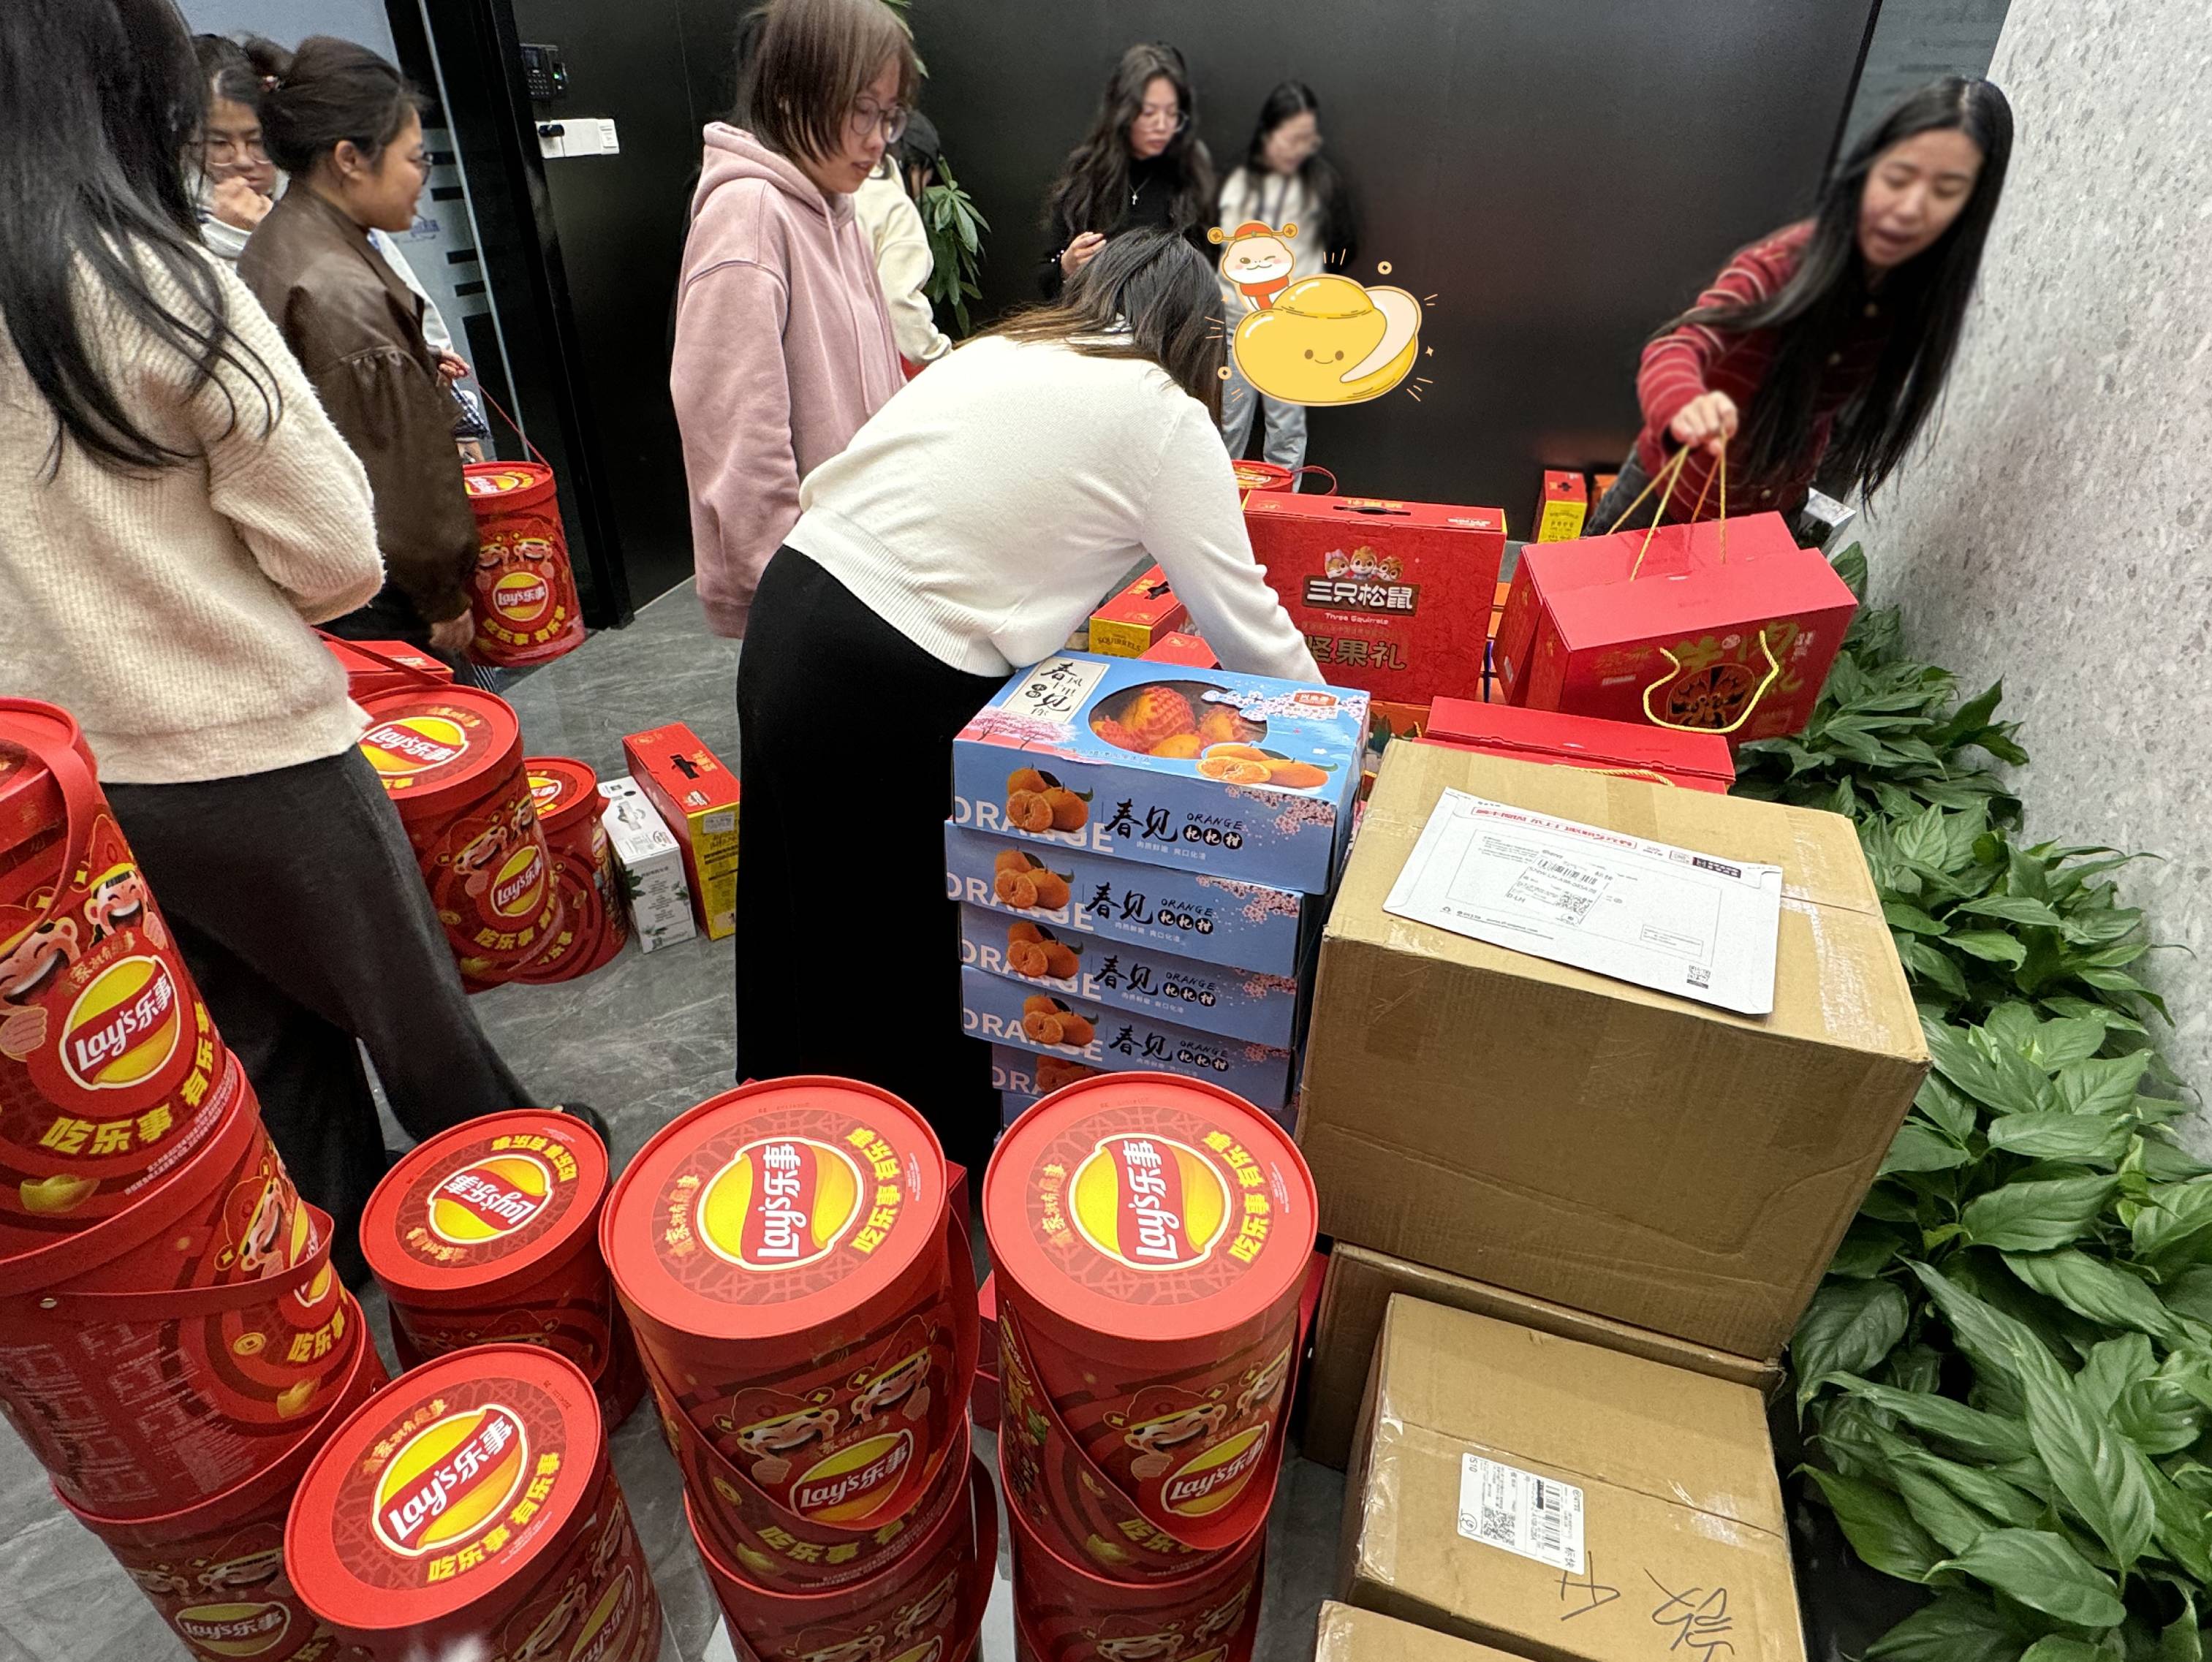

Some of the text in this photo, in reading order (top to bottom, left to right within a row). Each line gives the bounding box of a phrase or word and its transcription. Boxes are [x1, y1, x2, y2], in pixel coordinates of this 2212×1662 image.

[1307, 580, 1413, 610] 三只松鼠
[1325, 612, 1389, 626] Three Squirrels
[1097, 636, 1142, 652] SQUIRRELS
[1105, 798, 1178, 842] 春见
[1187, 812, 1243, 830] ORANGE
[1085, 881, 1154, 925] 春见
[1161, 898, 1214, 918] ORANGE
[1094, 955, 1159, 996] 春见
[1166, 971, 1217, 991] ORANGE
[75, 973, 172, 1072] Lay's乐事
[1108, 1025, 1174, 1060] 春见
[1181, 1039, 1229, 1058] ORANGE
[39, 1103, 173, 1156] 吃乐事
[180, 1001, 213, 1108] 有乐事
[444, 1175, 537, 1224] Lay's乐事
[757, 1142, 807, 1258] Lay's乐事
[844, 1127, 902, 1256] 吃乐事 有乐事
[1122, 1139, 1180, 1260] Lay's乐事
[1201, 1130, 1272, 1264] 吃乐事 有乐事
[387, 1414, 514, 1541] Lay's乐事
[800, 1439, 909, 1509] Lay's乐事
[426, 1452, 561, 1585] 吃乐事 有乐事
